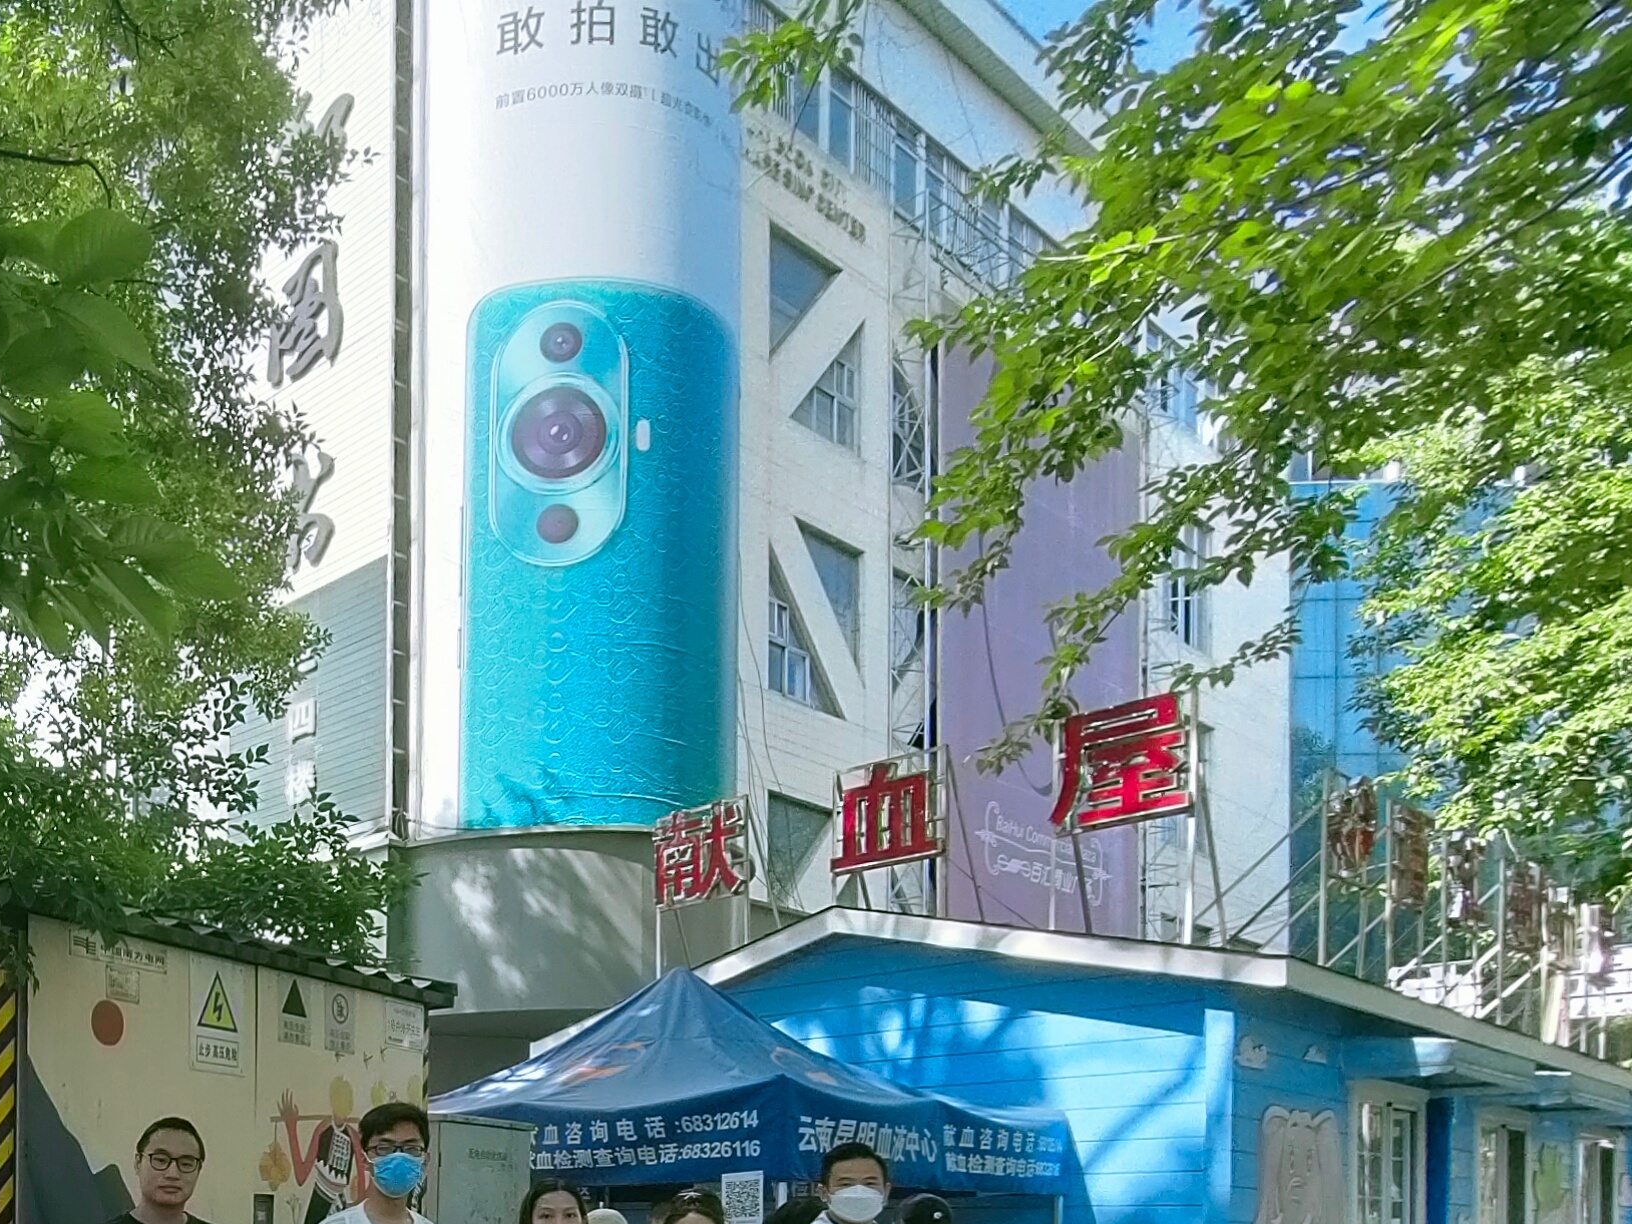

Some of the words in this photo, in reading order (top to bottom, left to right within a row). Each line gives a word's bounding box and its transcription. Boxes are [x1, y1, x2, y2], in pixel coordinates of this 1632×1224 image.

[653, 692, 1190, 905] 献血屋
[798, 1115, 939, 1164] 云南昆明血液中心
